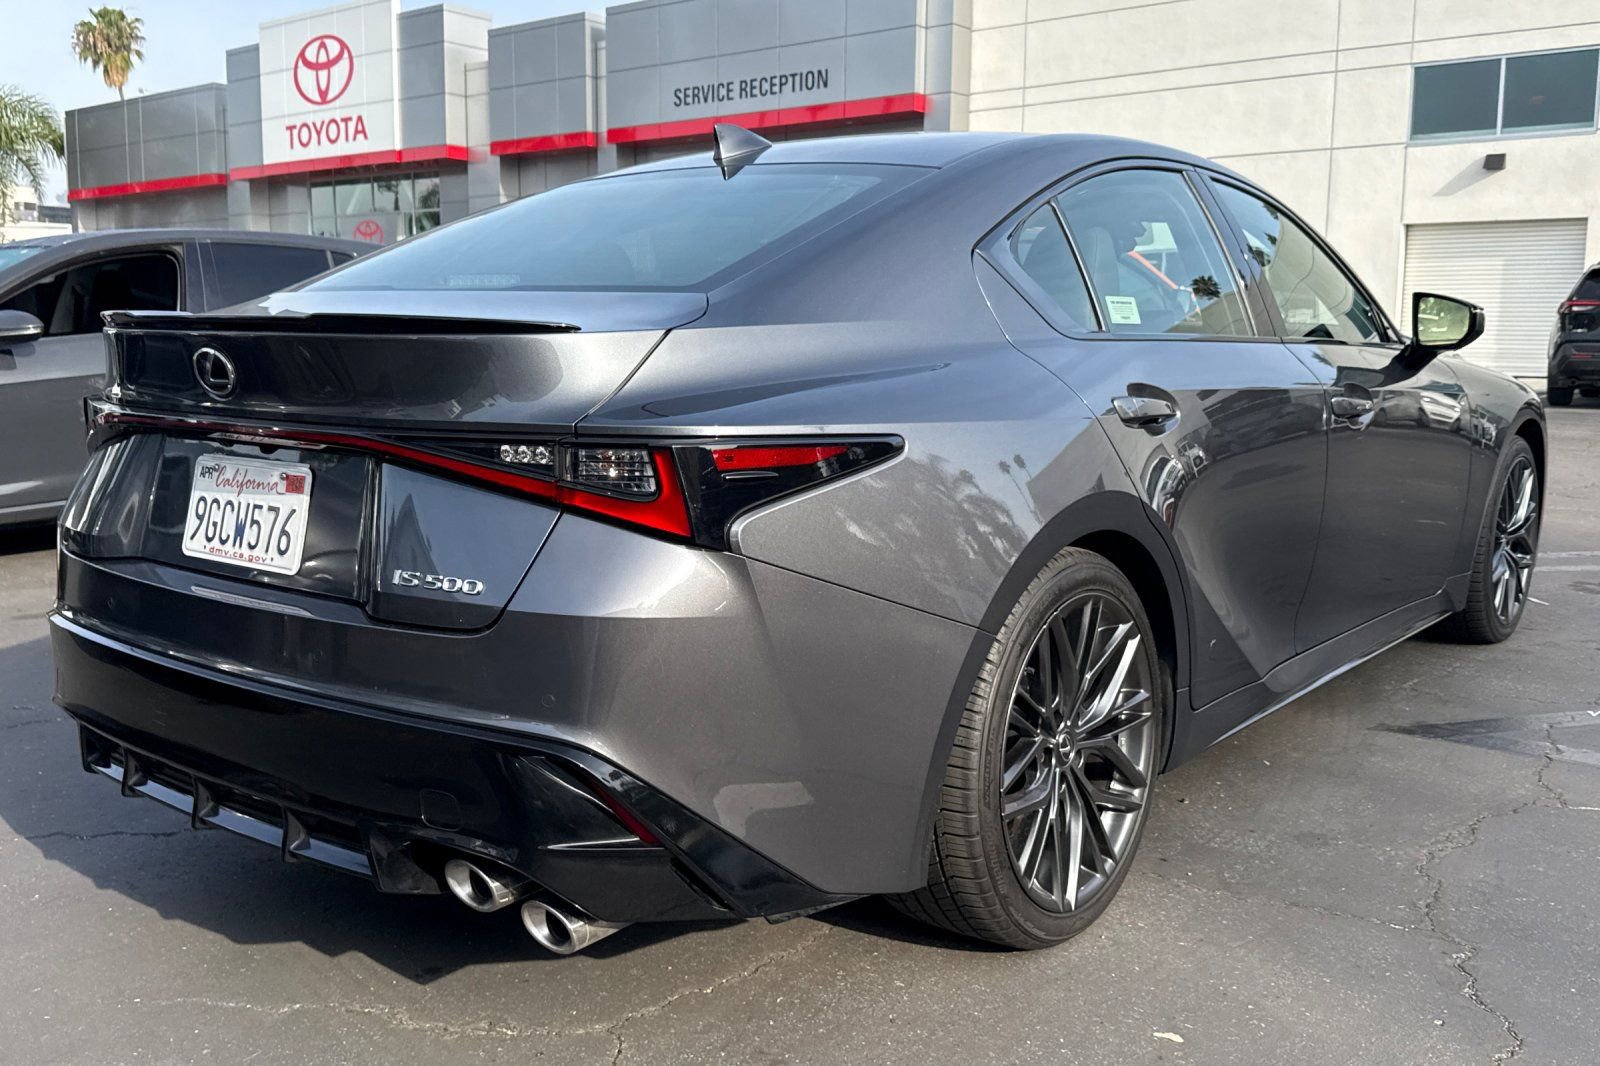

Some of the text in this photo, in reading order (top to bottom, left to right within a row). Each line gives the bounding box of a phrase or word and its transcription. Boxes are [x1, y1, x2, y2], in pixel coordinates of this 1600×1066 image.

[673, 68, 829, 108] SERVICE RECEPTION
[285, 115, 368, 149] TOYOTA
[199, 465, 214, 479] APR
[215, 465, 285, 497] California
[189, 496, 297, 556] 9GCW576
[208, 546, 268, 563] dmv.ca.gov
[392, 569, 484, 595] IS 500
